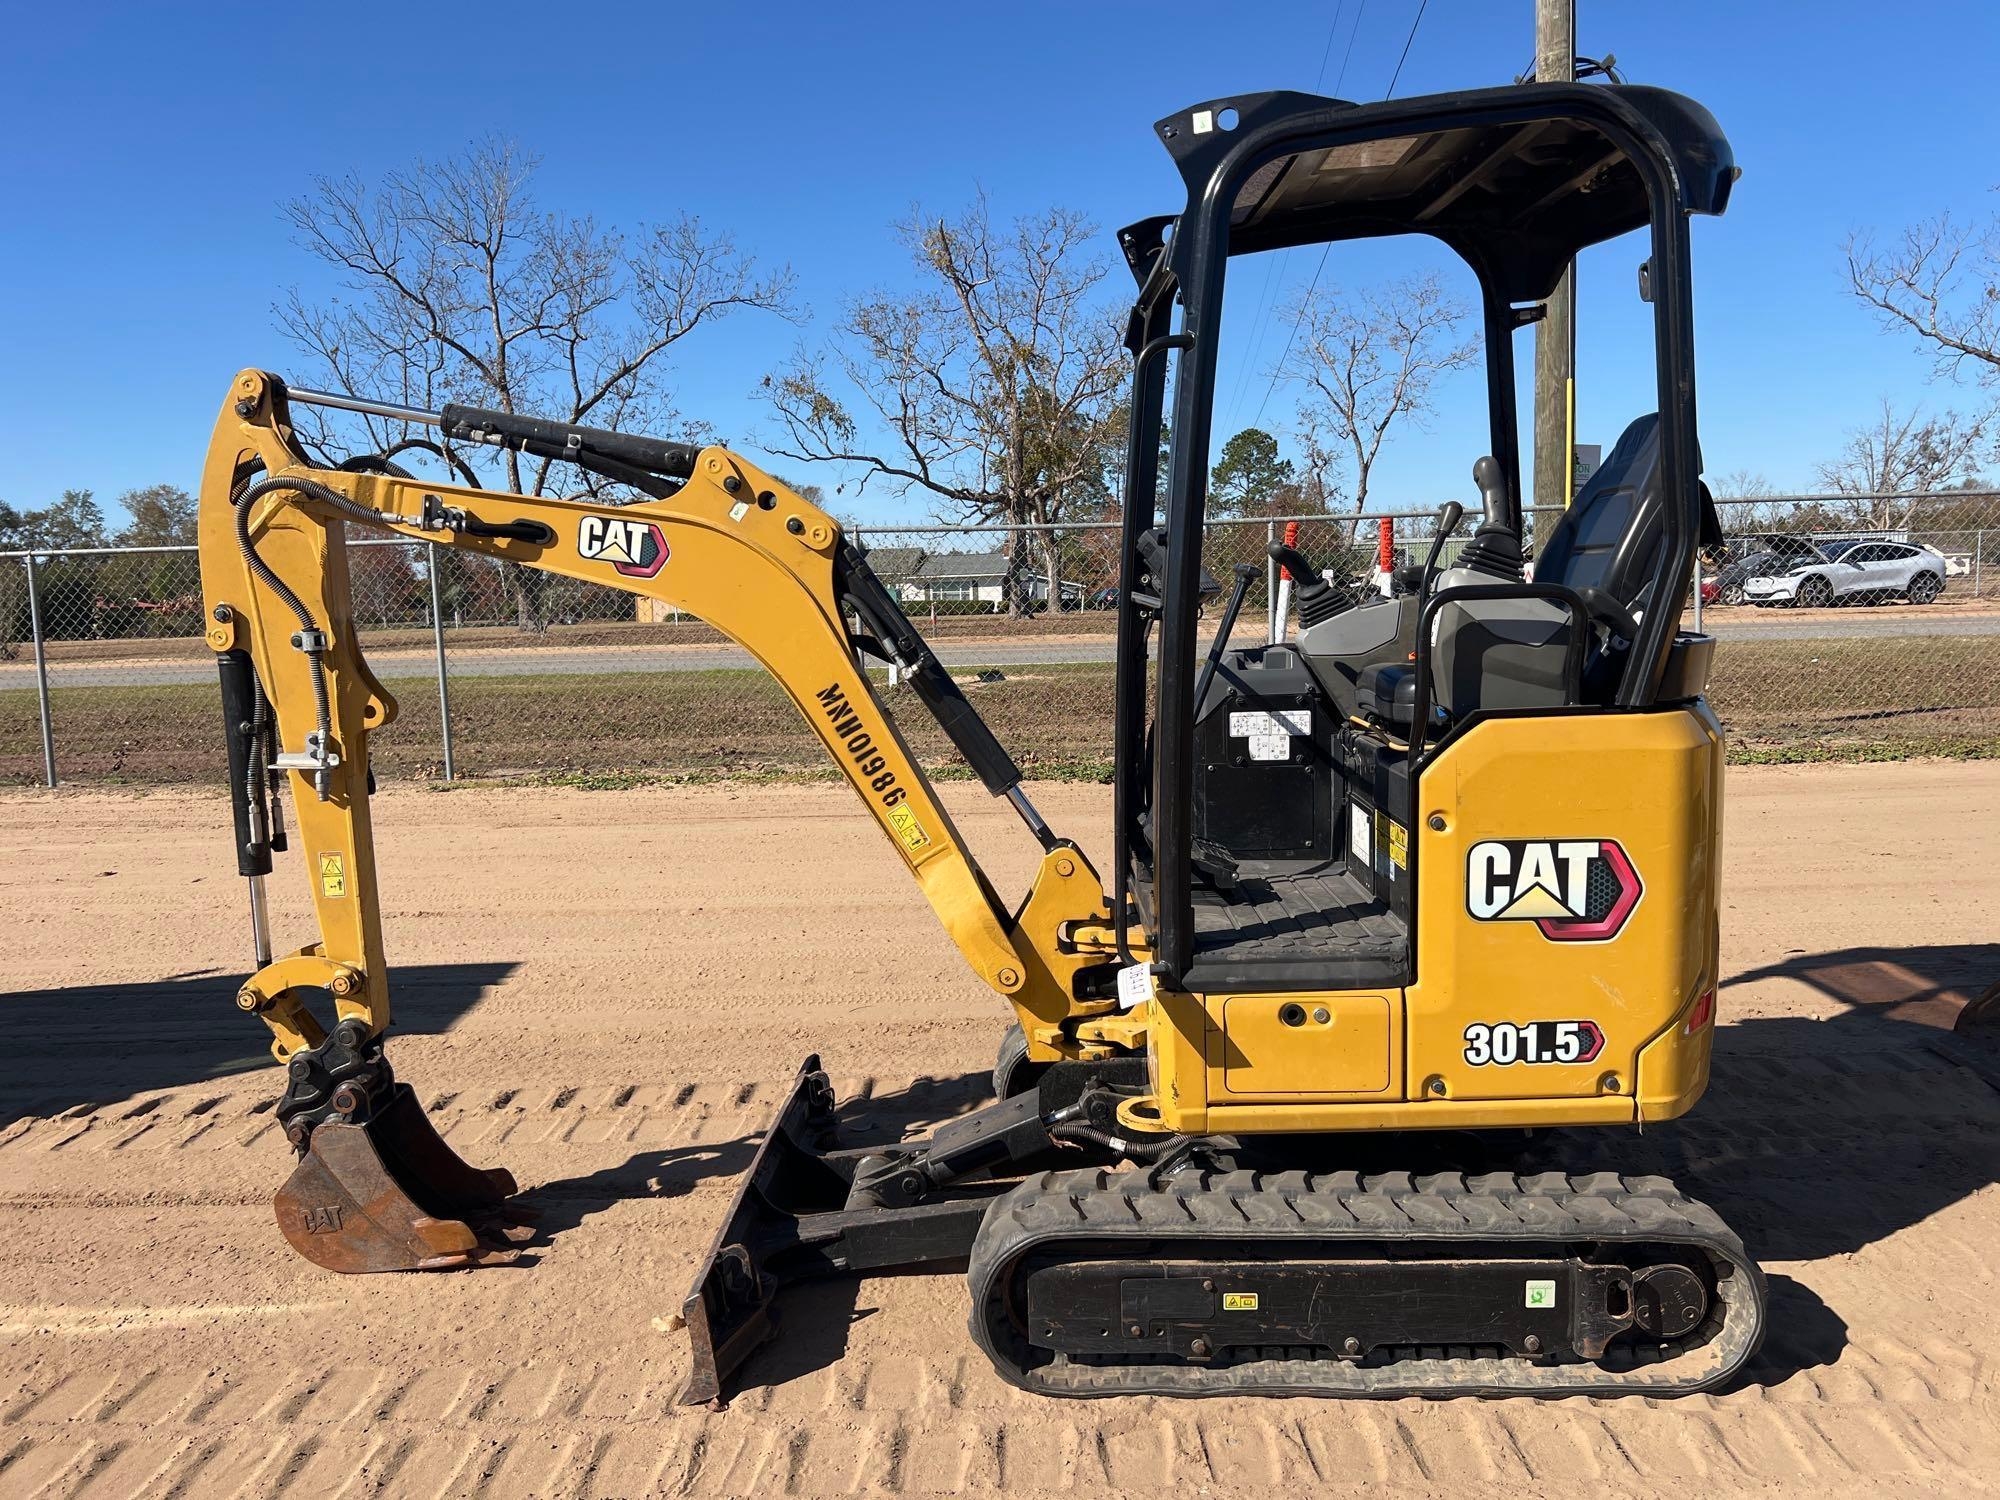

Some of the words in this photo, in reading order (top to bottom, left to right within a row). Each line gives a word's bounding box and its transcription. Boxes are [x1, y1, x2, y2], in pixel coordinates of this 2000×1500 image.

[579, 516, 649, 565] CAT
[815, 682, 907, 808] MNH01986
[1469, 841, 1600, 919] CAT
[1465, 1022, 1580, 1064] 301.5
[299, 1205, 344, 1235] CAT
